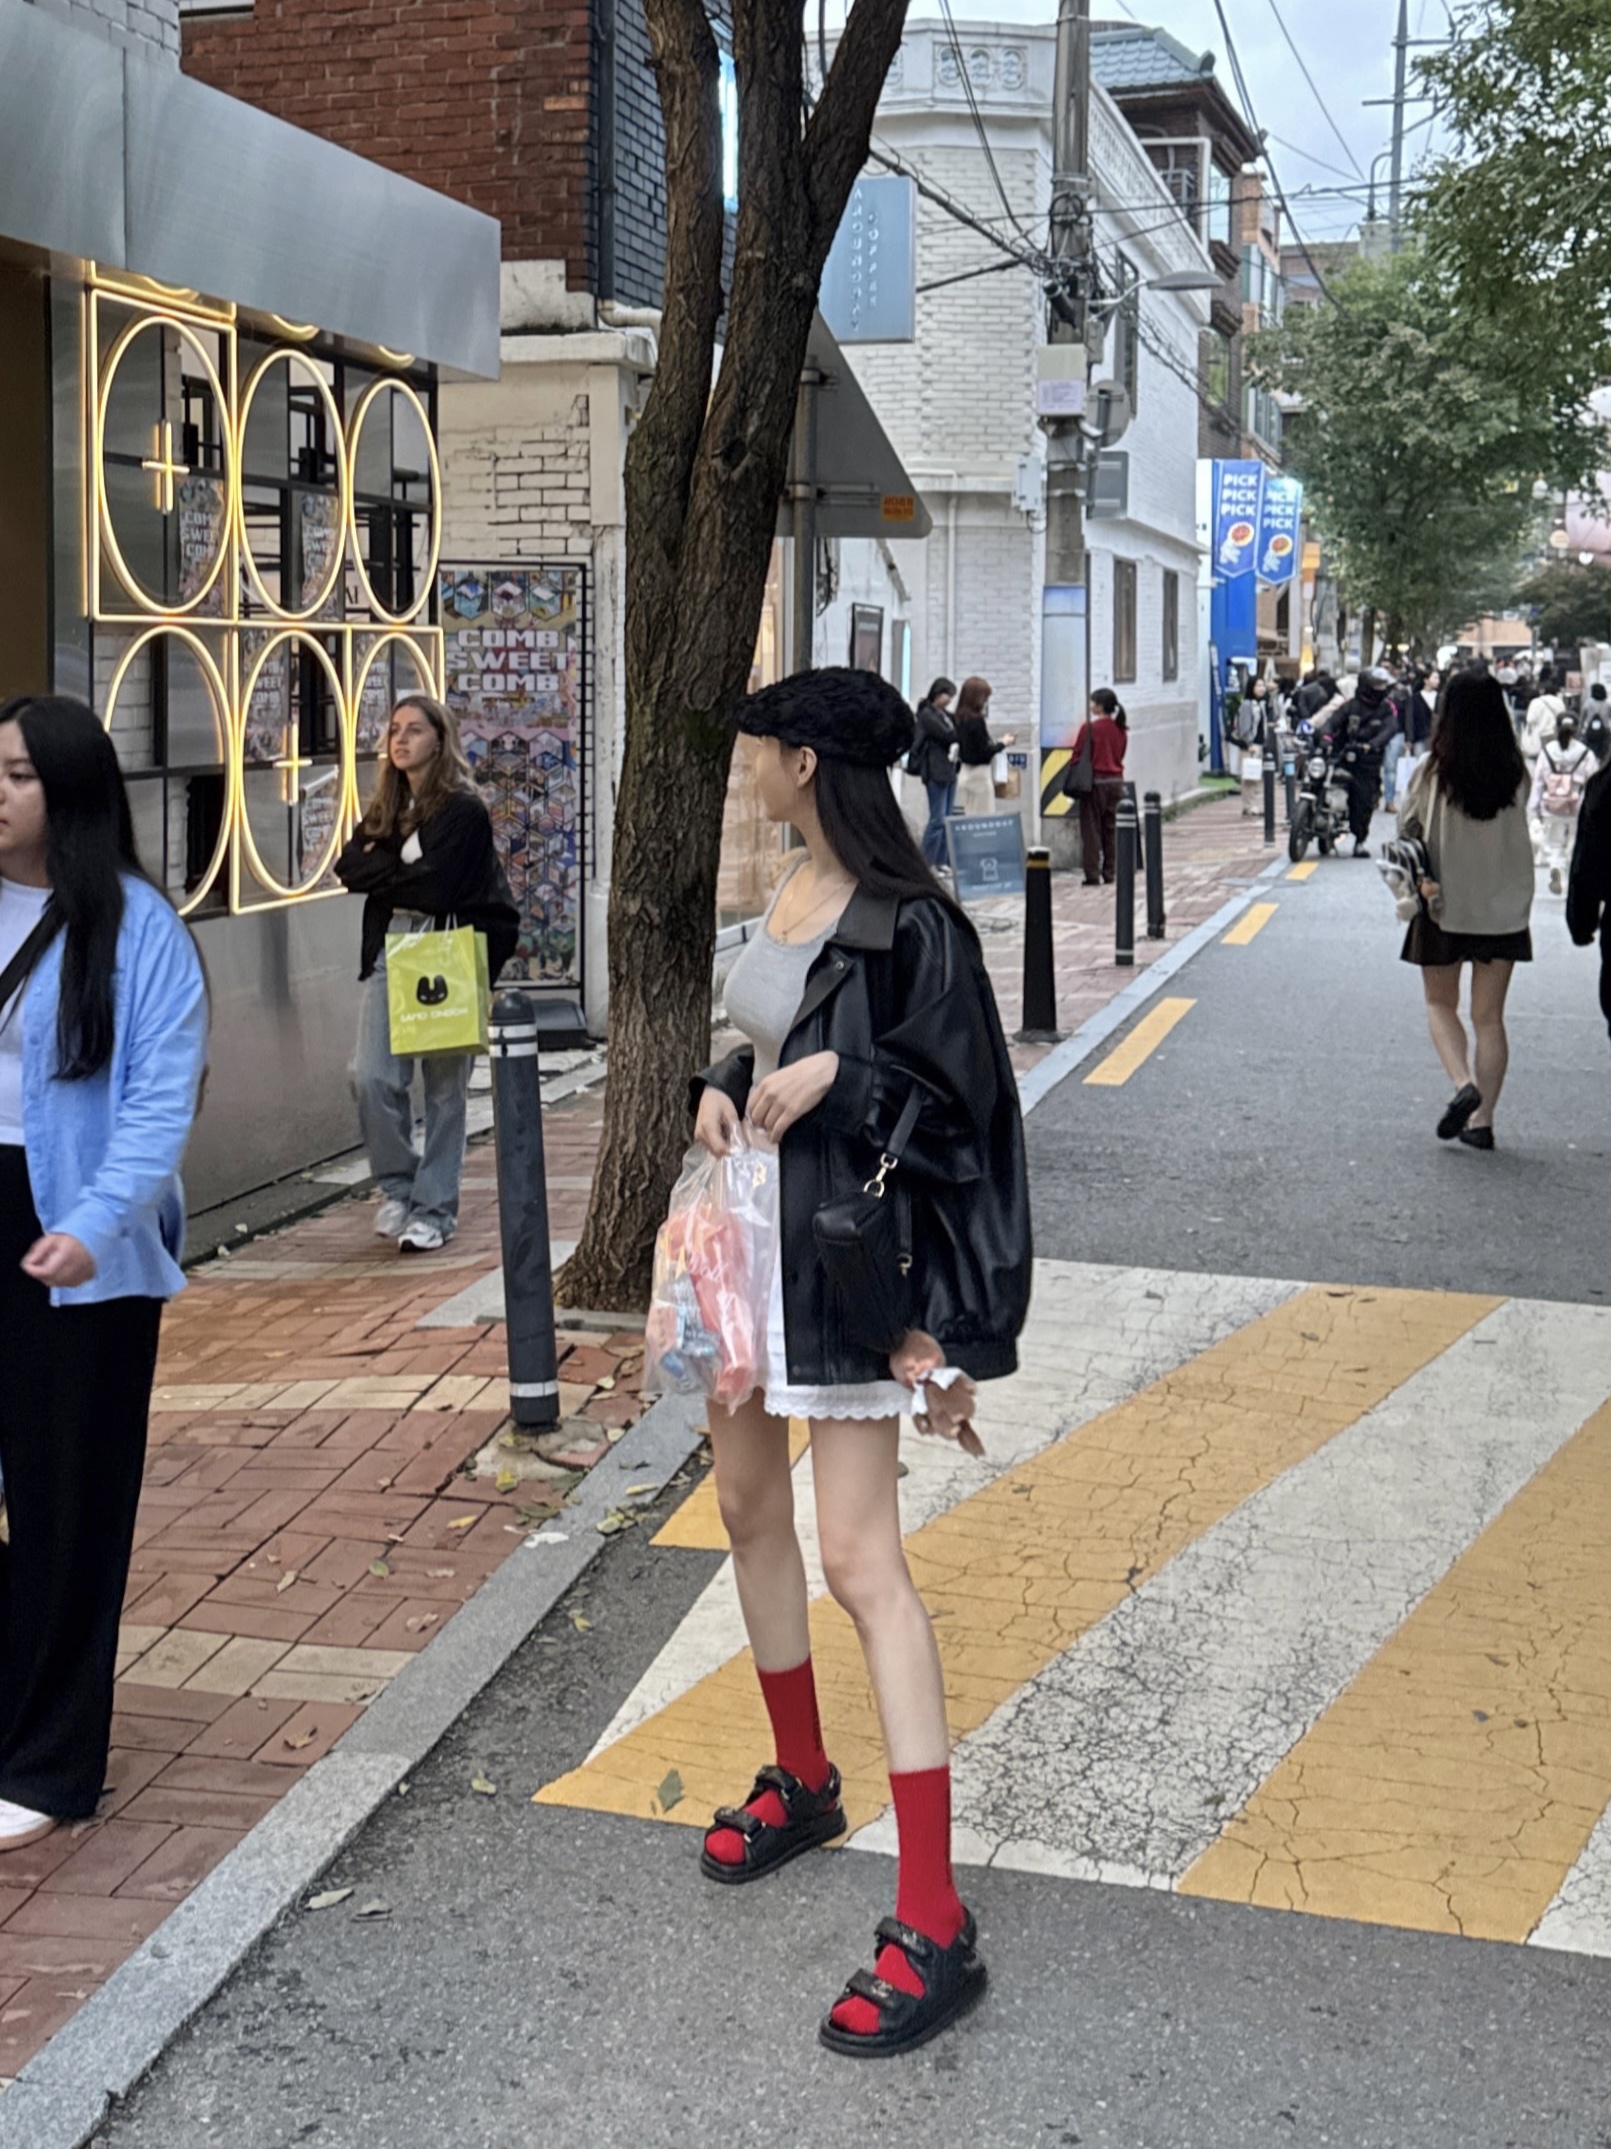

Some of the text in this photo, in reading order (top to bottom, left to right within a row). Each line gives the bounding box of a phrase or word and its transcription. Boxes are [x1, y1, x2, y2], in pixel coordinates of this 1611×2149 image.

[1223, 473, 1258, 487] PICK
[1221, 488, 1257, 501] PICK
[1220, 502, 1256, 516] PICK
[1264, 504, 1294, 516] PICK
[1262, 518, 1294, 530] PICK
[458, 630, 559, 648] COMB
[446, 651, 568, 670] SWEET
[458, 673, 559, 692] COMB
